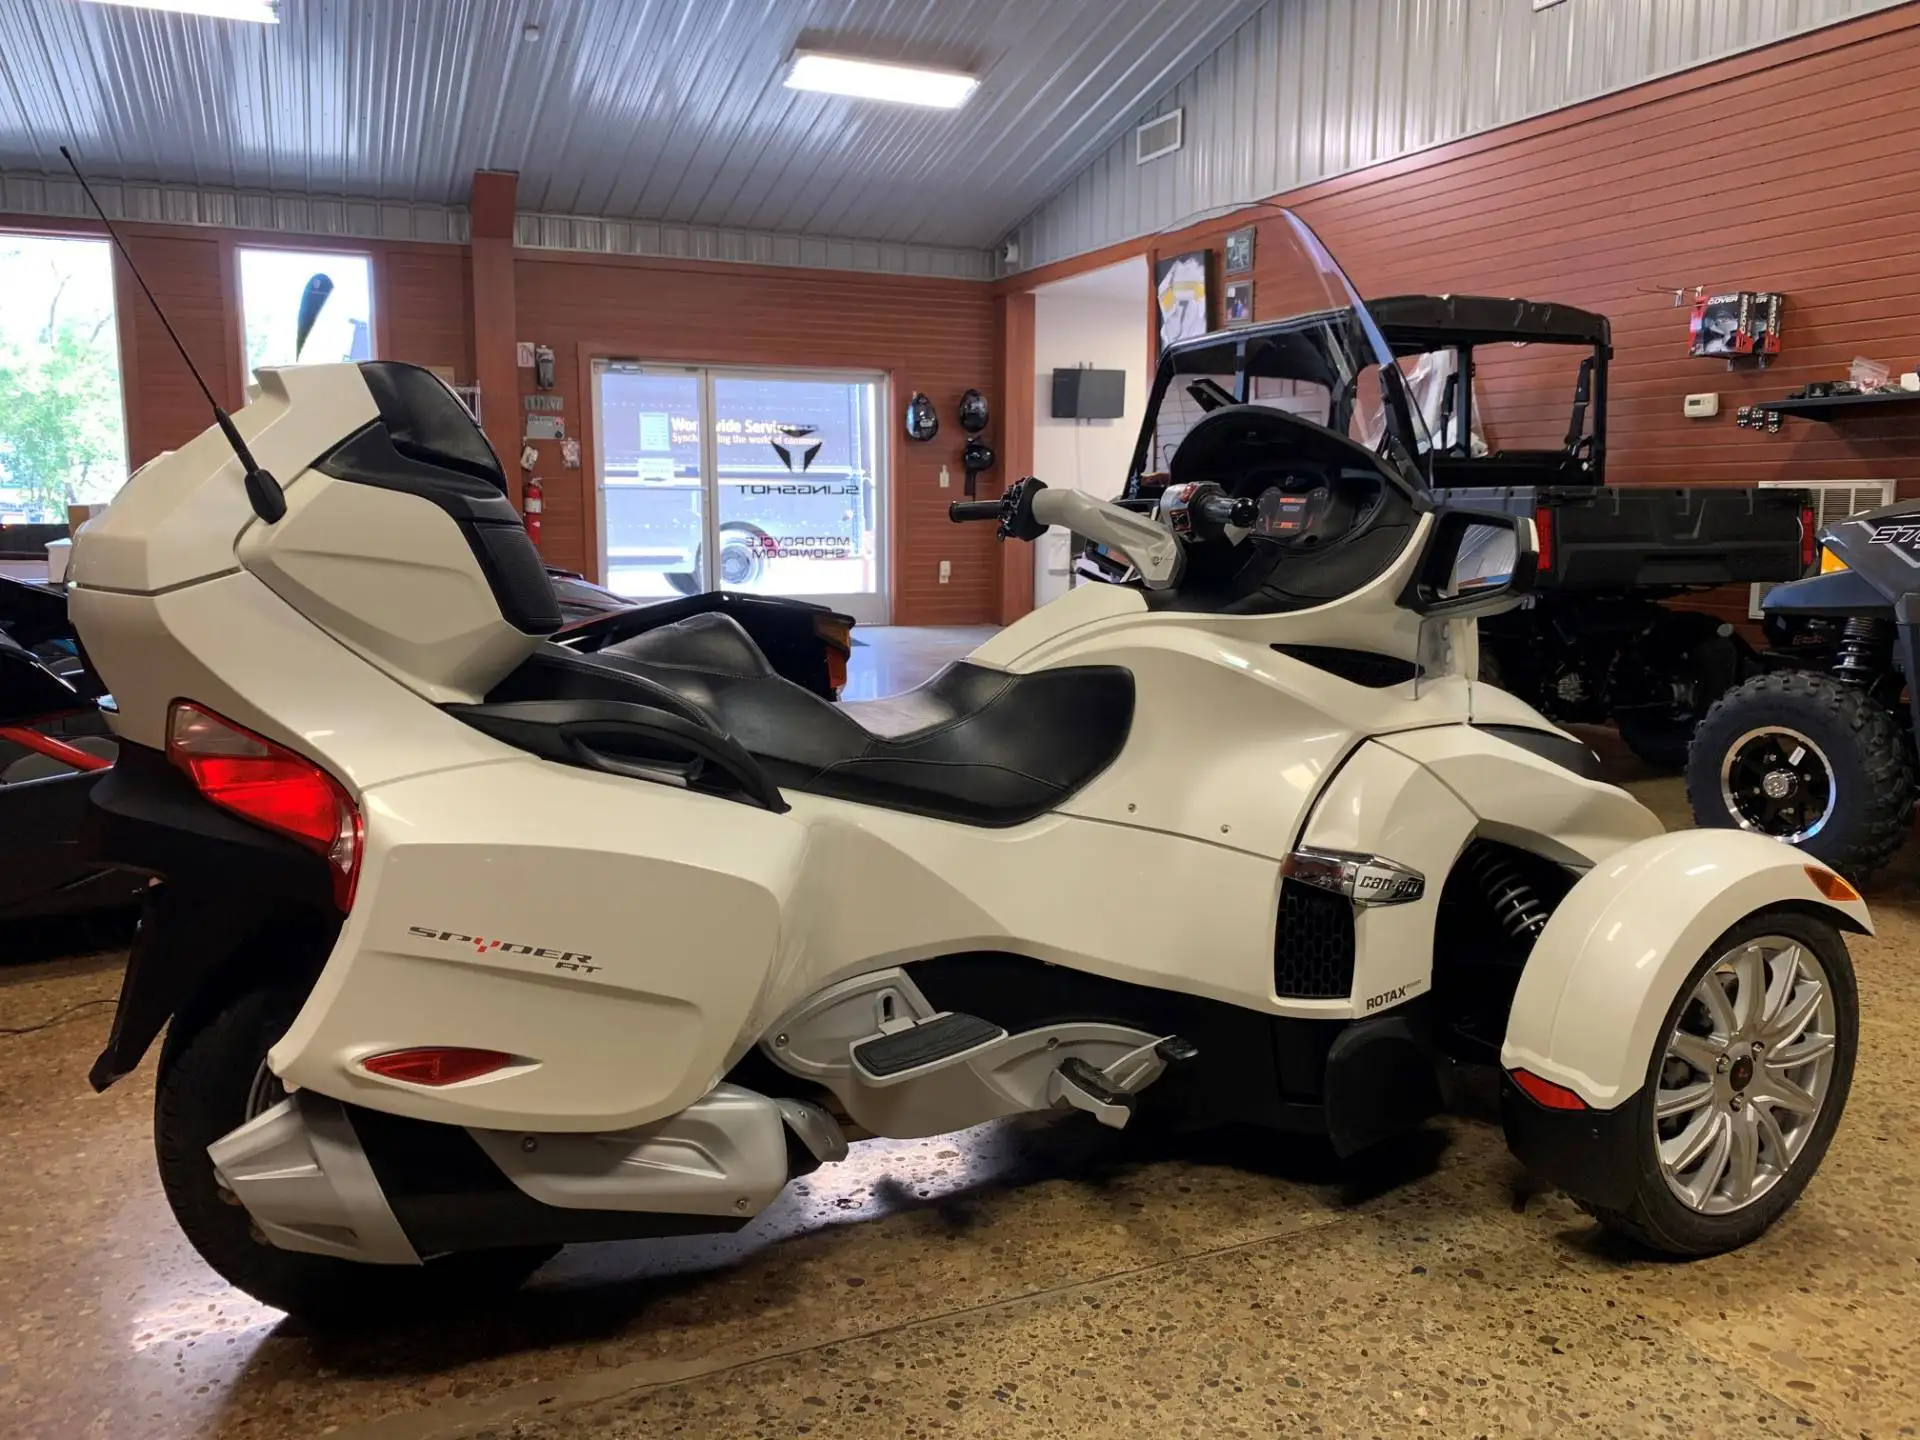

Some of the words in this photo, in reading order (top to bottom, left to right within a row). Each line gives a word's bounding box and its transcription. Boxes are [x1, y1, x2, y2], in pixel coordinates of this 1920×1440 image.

[671, 416, 742, 434] Woride
[671, 433, 731, 446] Synching
[408, 926, 593, 964] SPYDER
[1366, 985, 1407, 1011] ROTAX
